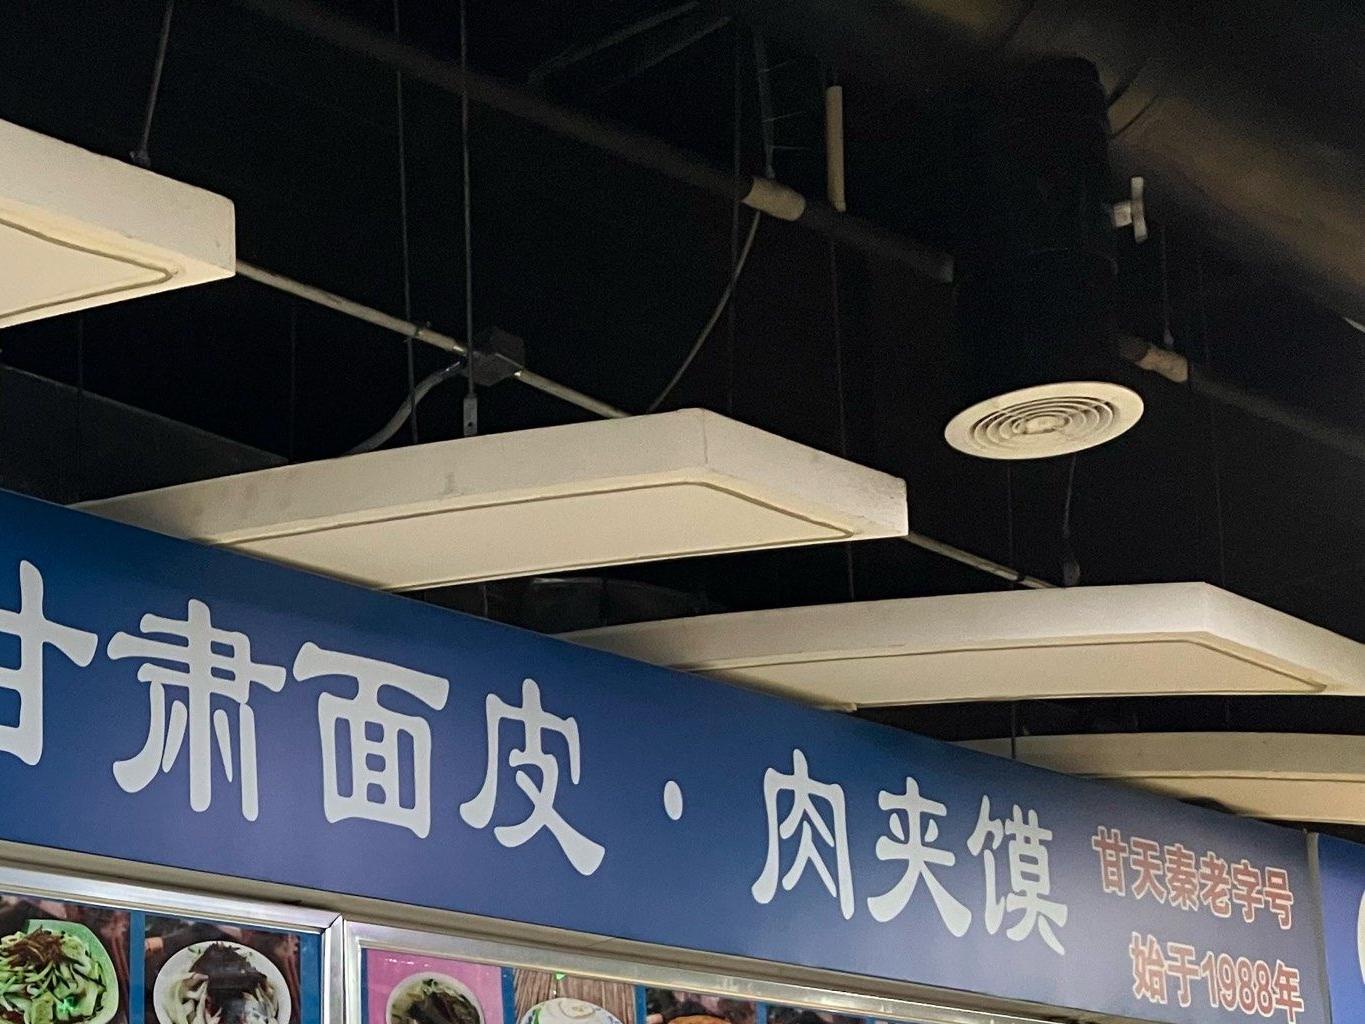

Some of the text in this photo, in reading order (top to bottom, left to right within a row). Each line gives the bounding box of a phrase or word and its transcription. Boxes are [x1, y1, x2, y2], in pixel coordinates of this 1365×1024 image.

[1092, 826, 1294, 929] 甘天秦老字号
[1129, 932, 1304, 1024] 始于1988年
